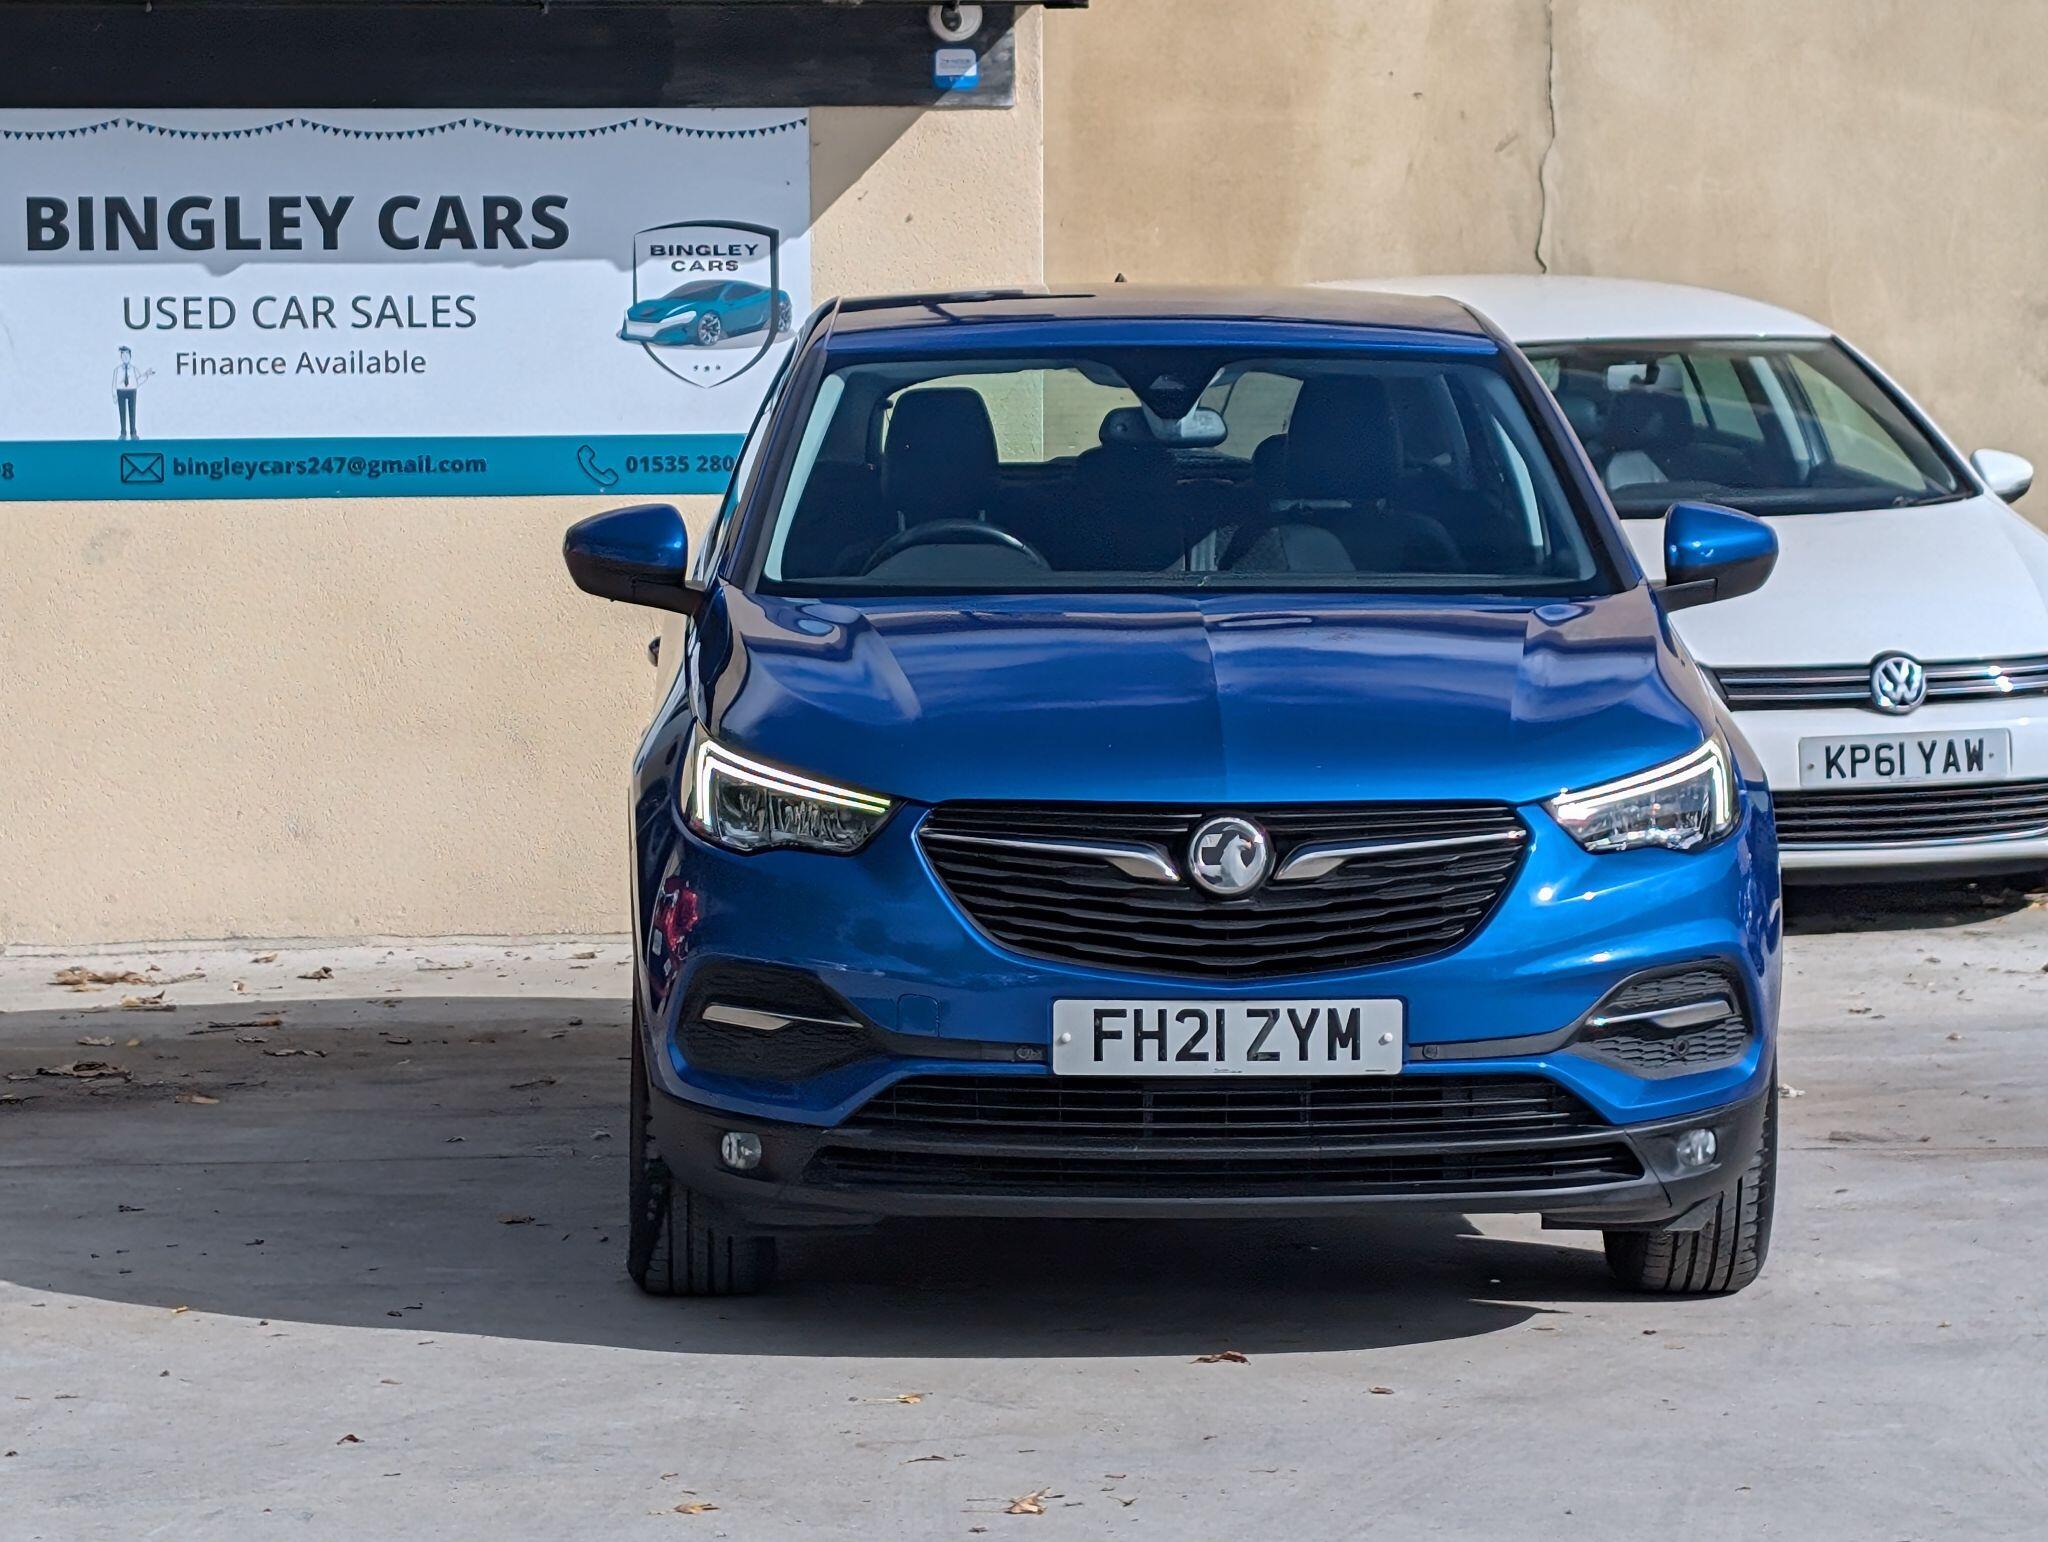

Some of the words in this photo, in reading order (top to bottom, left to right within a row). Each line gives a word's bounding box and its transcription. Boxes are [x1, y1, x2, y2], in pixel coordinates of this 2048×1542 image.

[26, 195, 355, 252] BINGLEY
[378, 195, 570, 251] CARS
[650, 243, 759, 257] BINGLEY
[670, 259, 739, 273] CARS
[123, 296, 236, 331] USED
[252, 295, 337, 330] CAR
[350, 295, 477, 329] SALES
[176, 351, 287, 377] Finance
[295, 349, 427, 375] Available
[173, 454, 487, 480] bingleycars247@gmail.com
[625, 455, 690, 474] 01535
[695, 454, 735, 473] 280
[1824, 742, 1906, 780] KP61
[1917, 738, 1984, 775] YAW
[1093, 1008, 1226, 1062] FH21
[1246, 1007, 1361, 1062] ZYM
